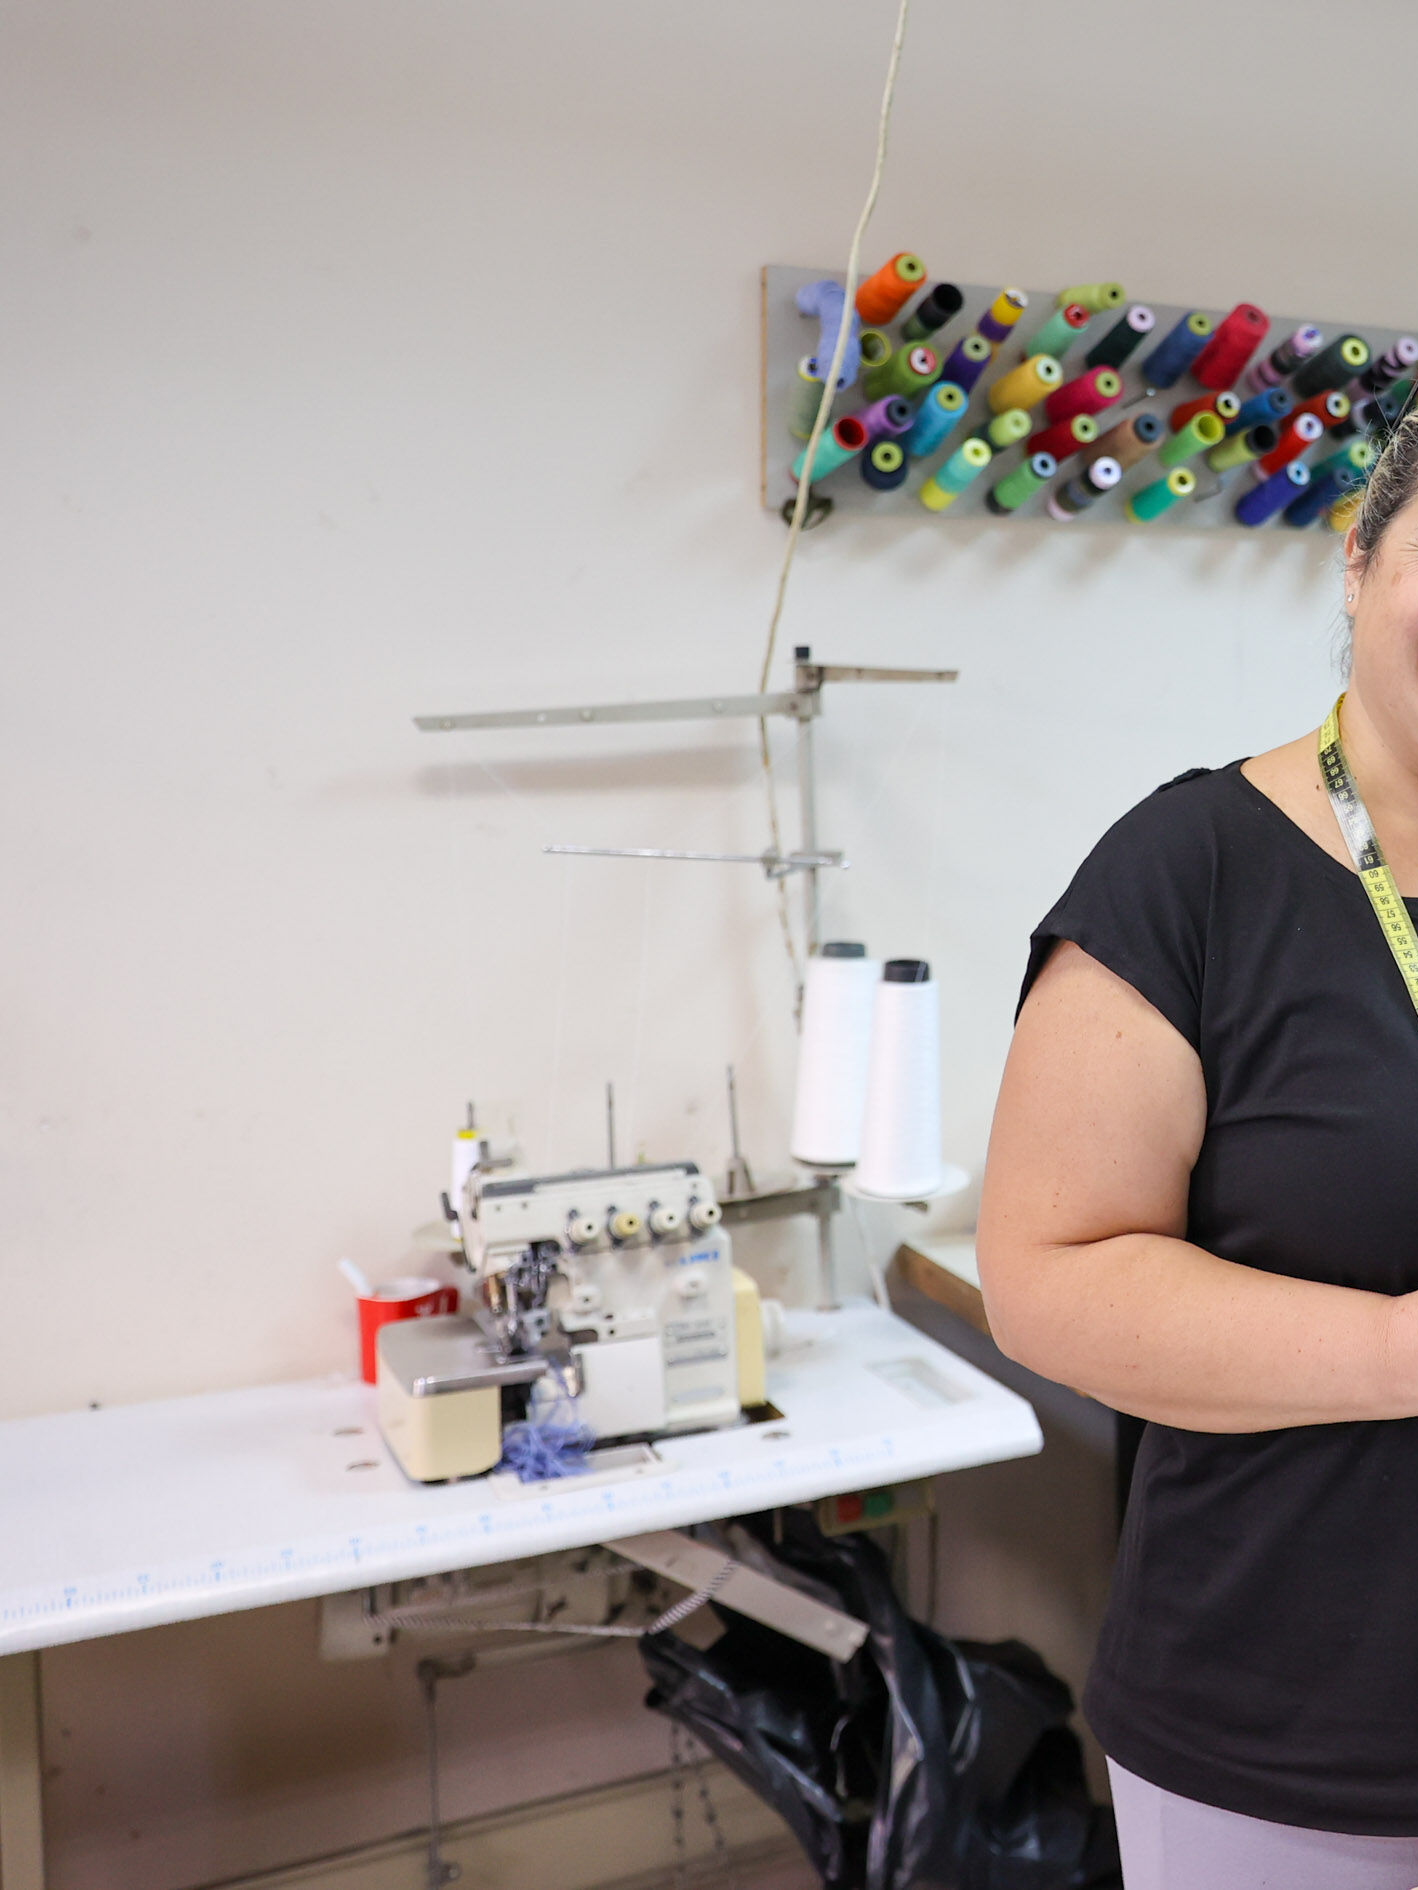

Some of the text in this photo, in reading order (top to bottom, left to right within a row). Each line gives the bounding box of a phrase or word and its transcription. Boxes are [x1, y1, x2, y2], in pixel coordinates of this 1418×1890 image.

[1326, 756, 1336, 766] 69
[1330, 767, 1339, 776] 68
[1334, 779, 1344, 788] 67
[1338, 792, 1349, 800] 66
[1364, 856, 1374, 865] 61
[1369, 869, 1379, 878] 60
[1374, 884, 1384, 892] 59
[1380, 897, 1390, 905] 58
[1387, 910, 1395, 919] 57
[1391, 923, 1401, 931] 56
[1397, 937, 1407, 945] 55
[1409, 964, 1418, 972] 53
